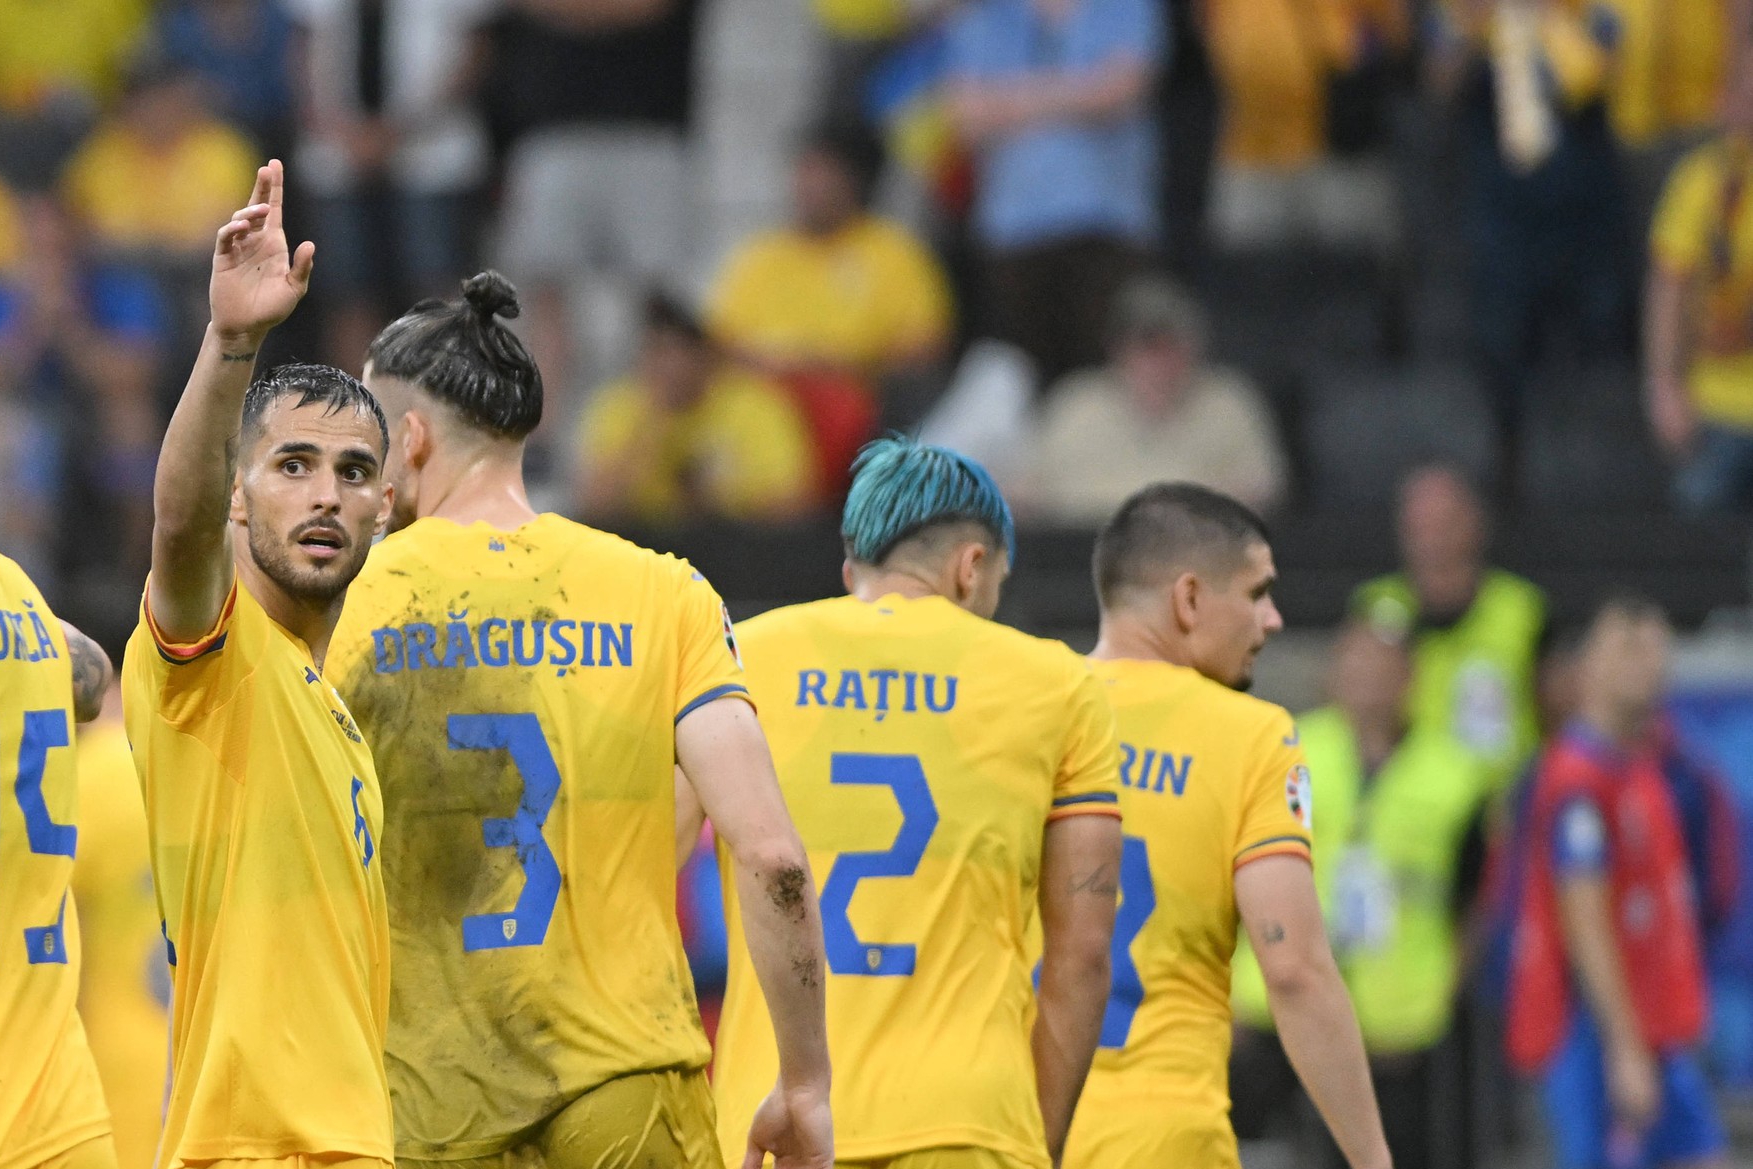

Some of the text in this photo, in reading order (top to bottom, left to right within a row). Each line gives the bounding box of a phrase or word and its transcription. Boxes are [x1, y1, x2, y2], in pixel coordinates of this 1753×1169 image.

[371, 608, 634, 677] DRĂGUȘIN
[796, 670, 958, 721] RAȚIU
[1118, 742, 1193, 797] RIN
[447, 713, 562, 953] 3
[819, 752, 940, 977] 2
